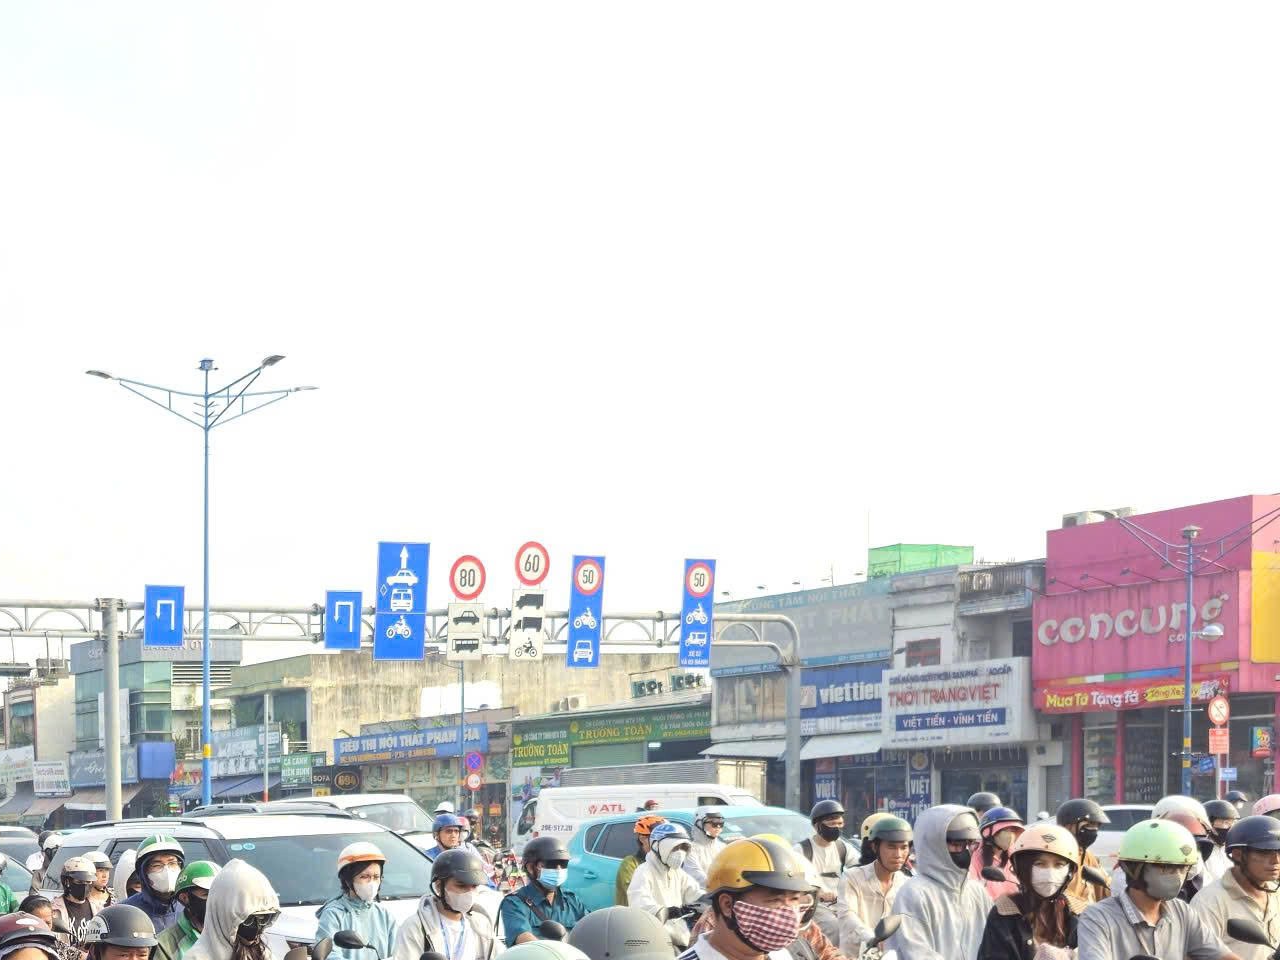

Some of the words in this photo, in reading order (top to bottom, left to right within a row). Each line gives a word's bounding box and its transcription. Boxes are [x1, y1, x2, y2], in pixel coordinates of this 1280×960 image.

[524, 554, 540, 573] 60
[459, 568, 476, 588] 80
[582, 569, 594, 585] 50
[693, 572, 705, 588] 50
[922, 686, 968, 705] TRANG
[599, 804, 625, 813] ATL
